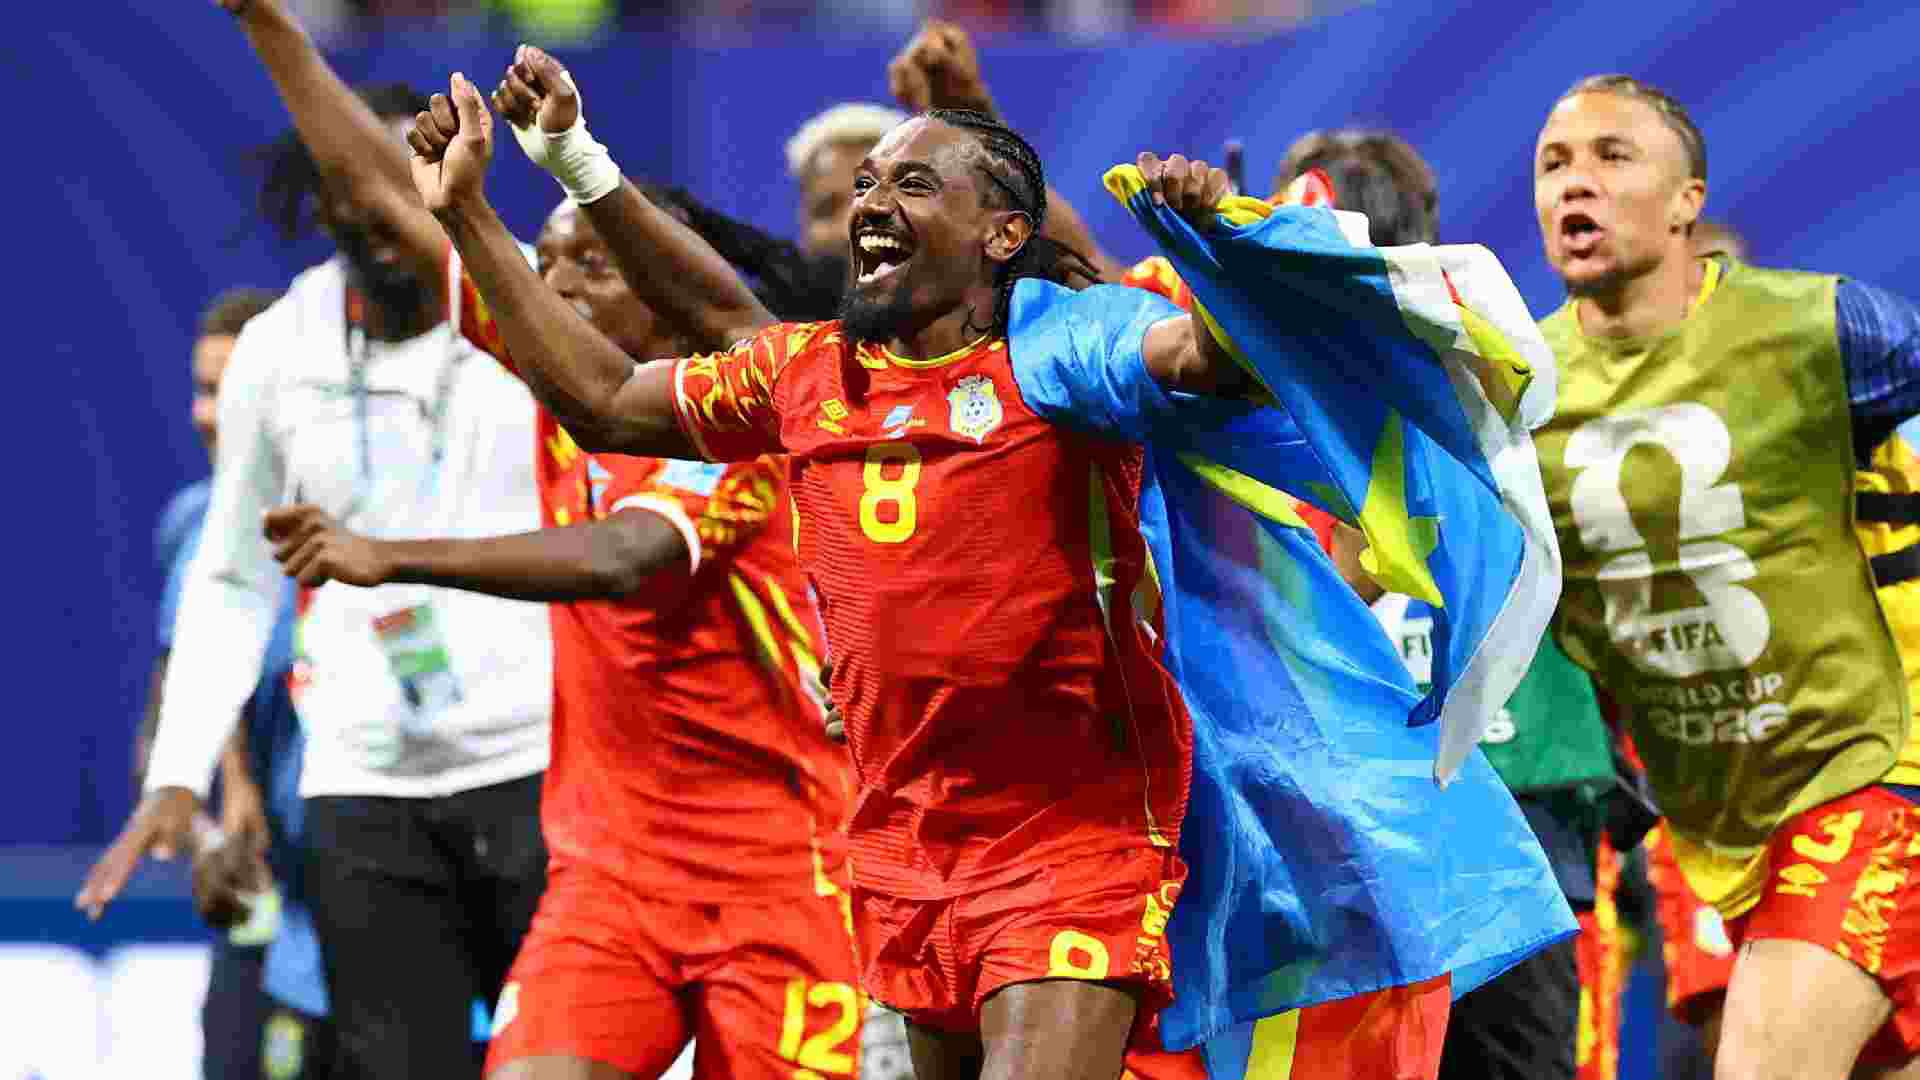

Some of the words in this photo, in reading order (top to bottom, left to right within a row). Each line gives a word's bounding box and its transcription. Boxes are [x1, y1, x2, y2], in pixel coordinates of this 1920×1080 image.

[859, 444, 922, 544] 8
[1401, 633, 1430, 660] FI
[1648, 622, 1727, 652] FIFA
[1727, 672, 1784, 704] CUP
[1649, 703, 1791, 745] 2026
[779, 977, 860, 1073] 12
